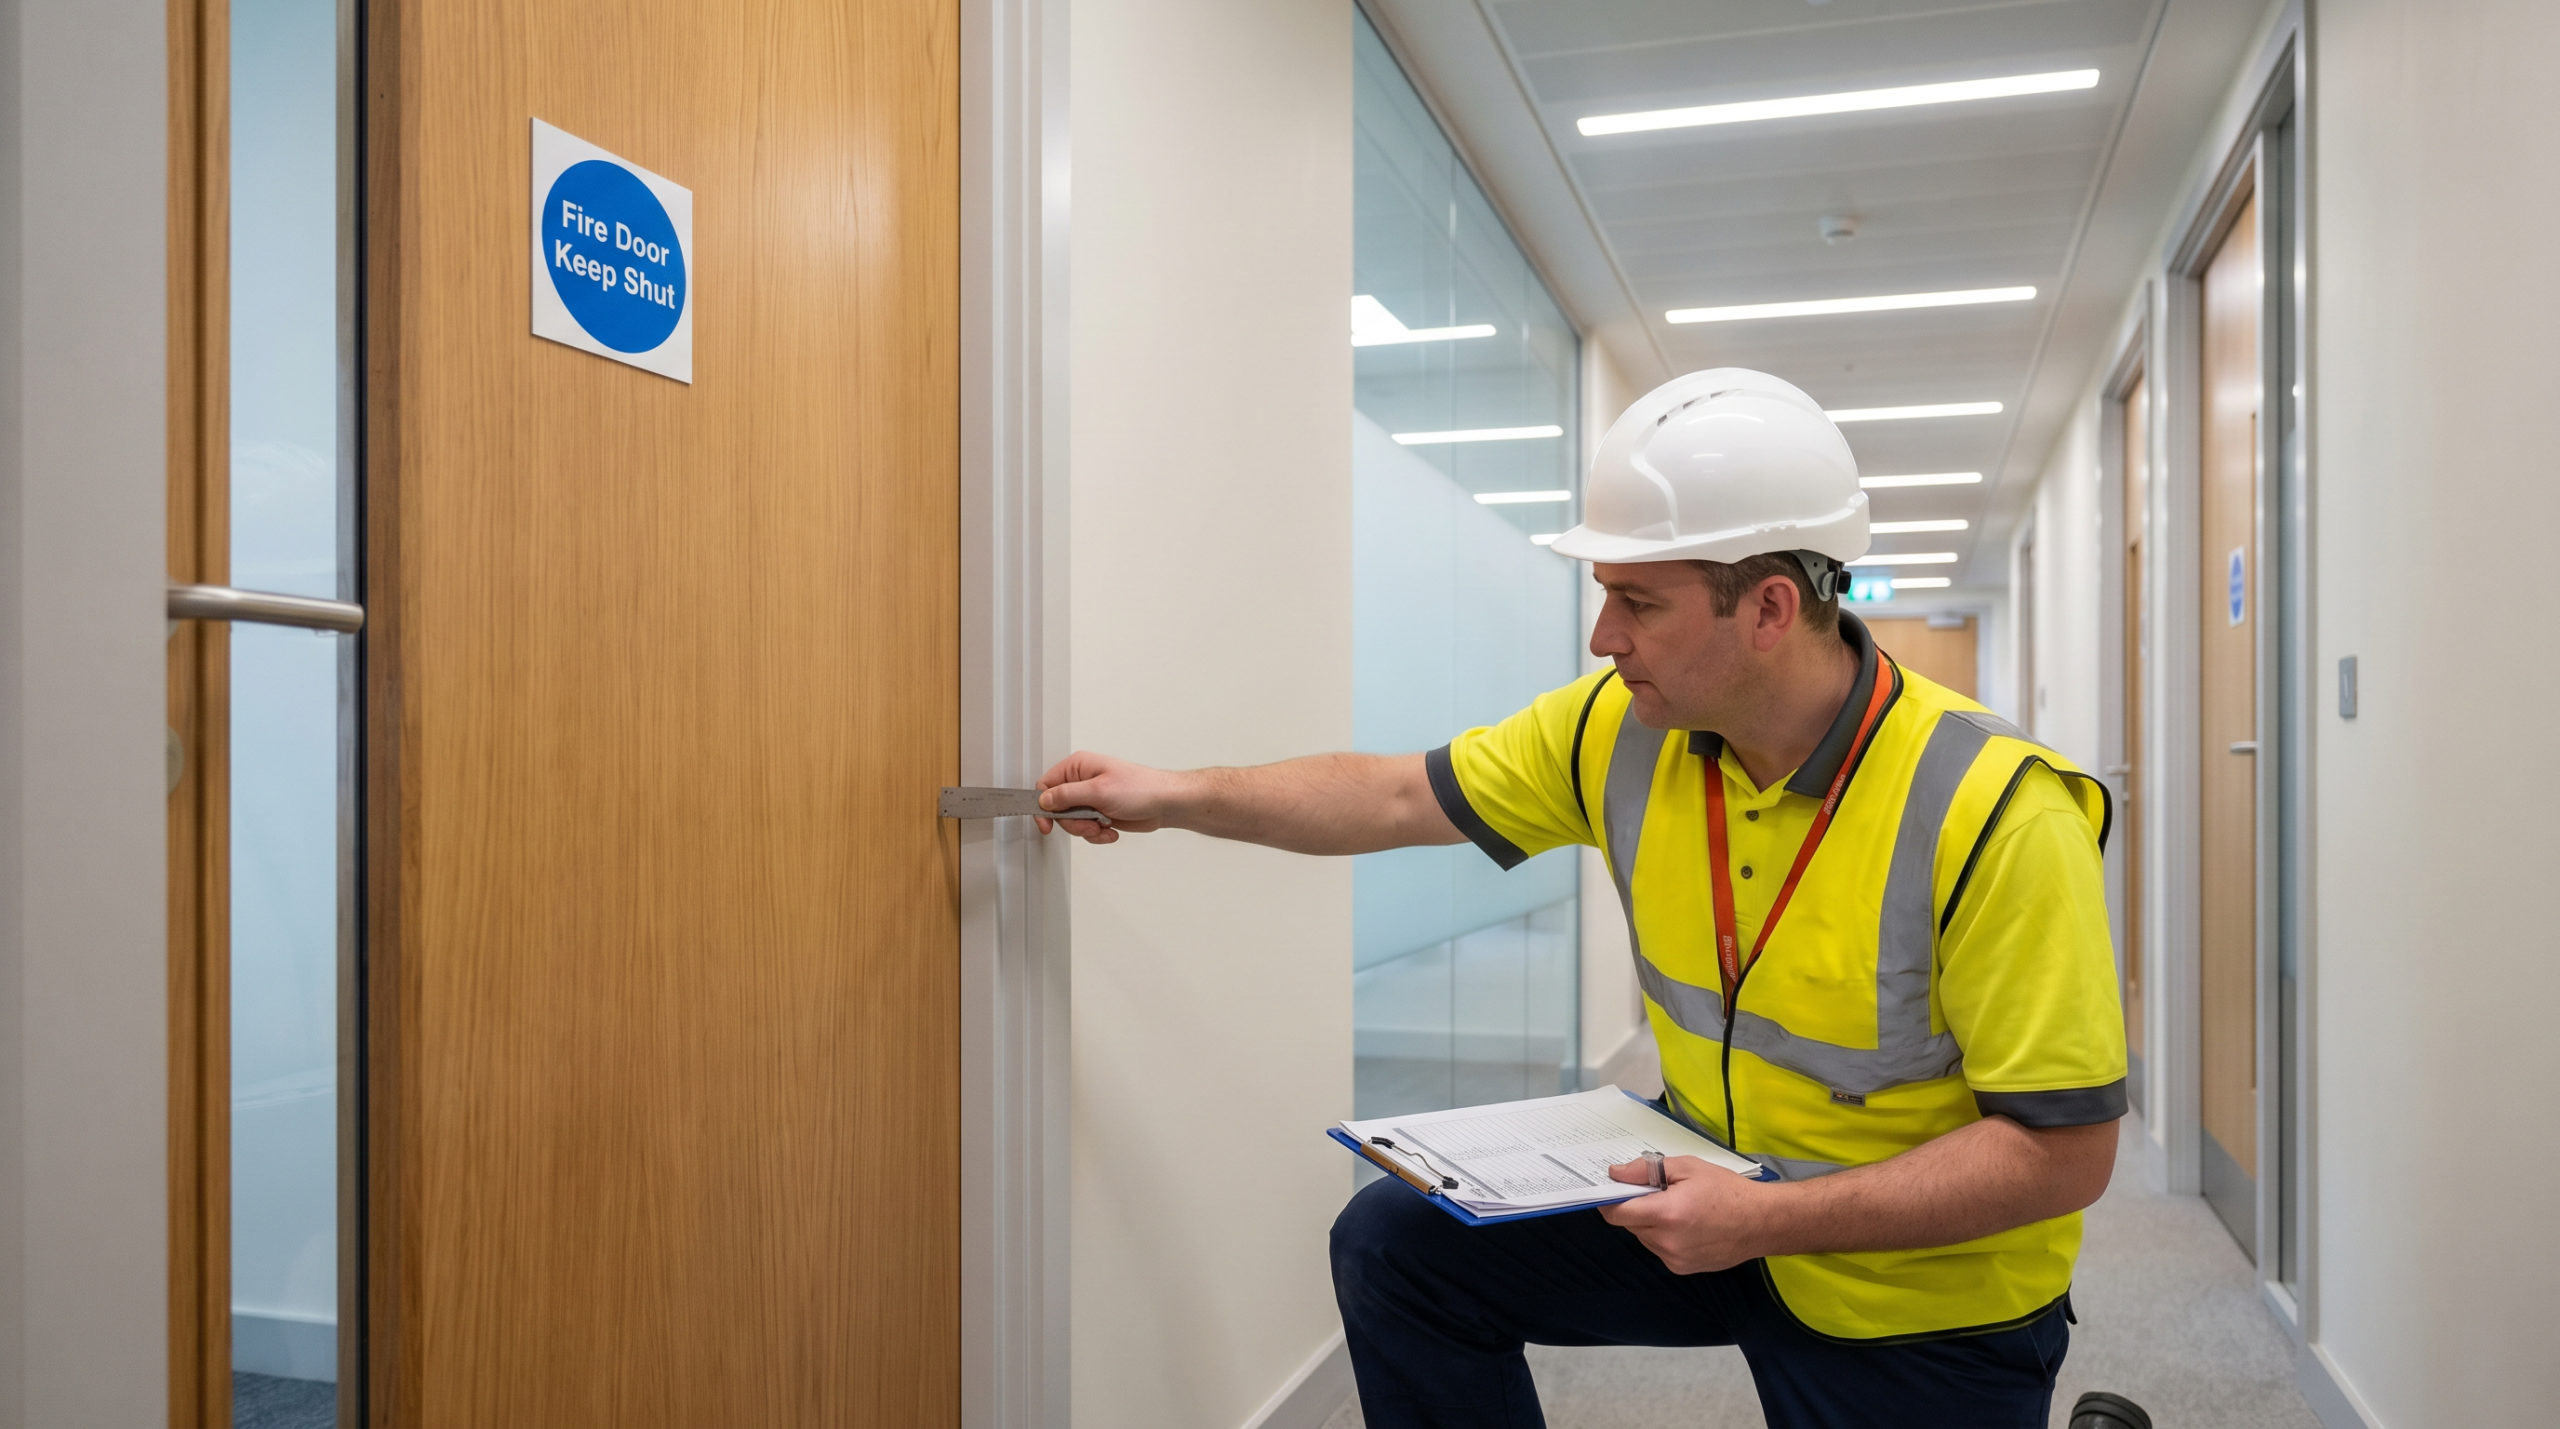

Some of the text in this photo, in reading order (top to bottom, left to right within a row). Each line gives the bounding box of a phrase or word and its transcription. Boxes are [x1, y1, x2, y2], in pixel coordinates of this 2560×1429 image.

[562, 199, 669, 266] Fire Door
[555, 238, 675, 309] Keep Shut
